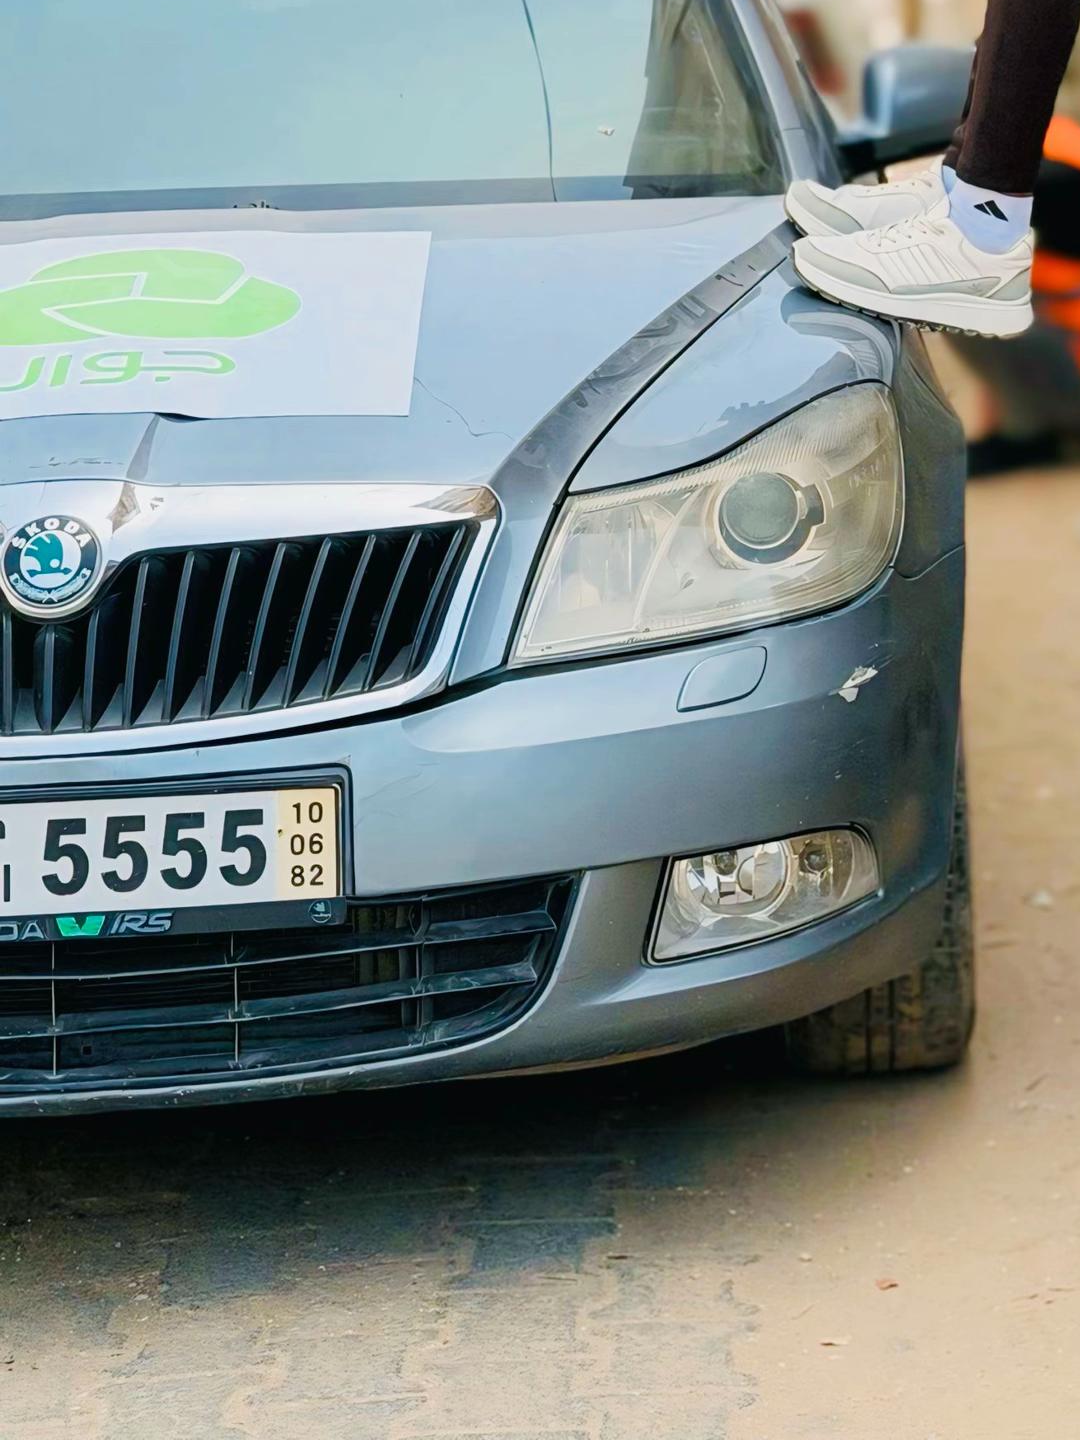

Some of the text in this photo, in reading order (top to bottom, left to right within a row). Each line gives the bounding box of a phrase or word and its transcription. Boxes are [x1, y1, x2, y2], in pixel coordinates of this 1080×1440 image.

[292, 801, 324, 824] 10
[41, 808, 267, 896] 5555
[290, 833, 324, 855] 06
[290, 864, 324, 887] 82
